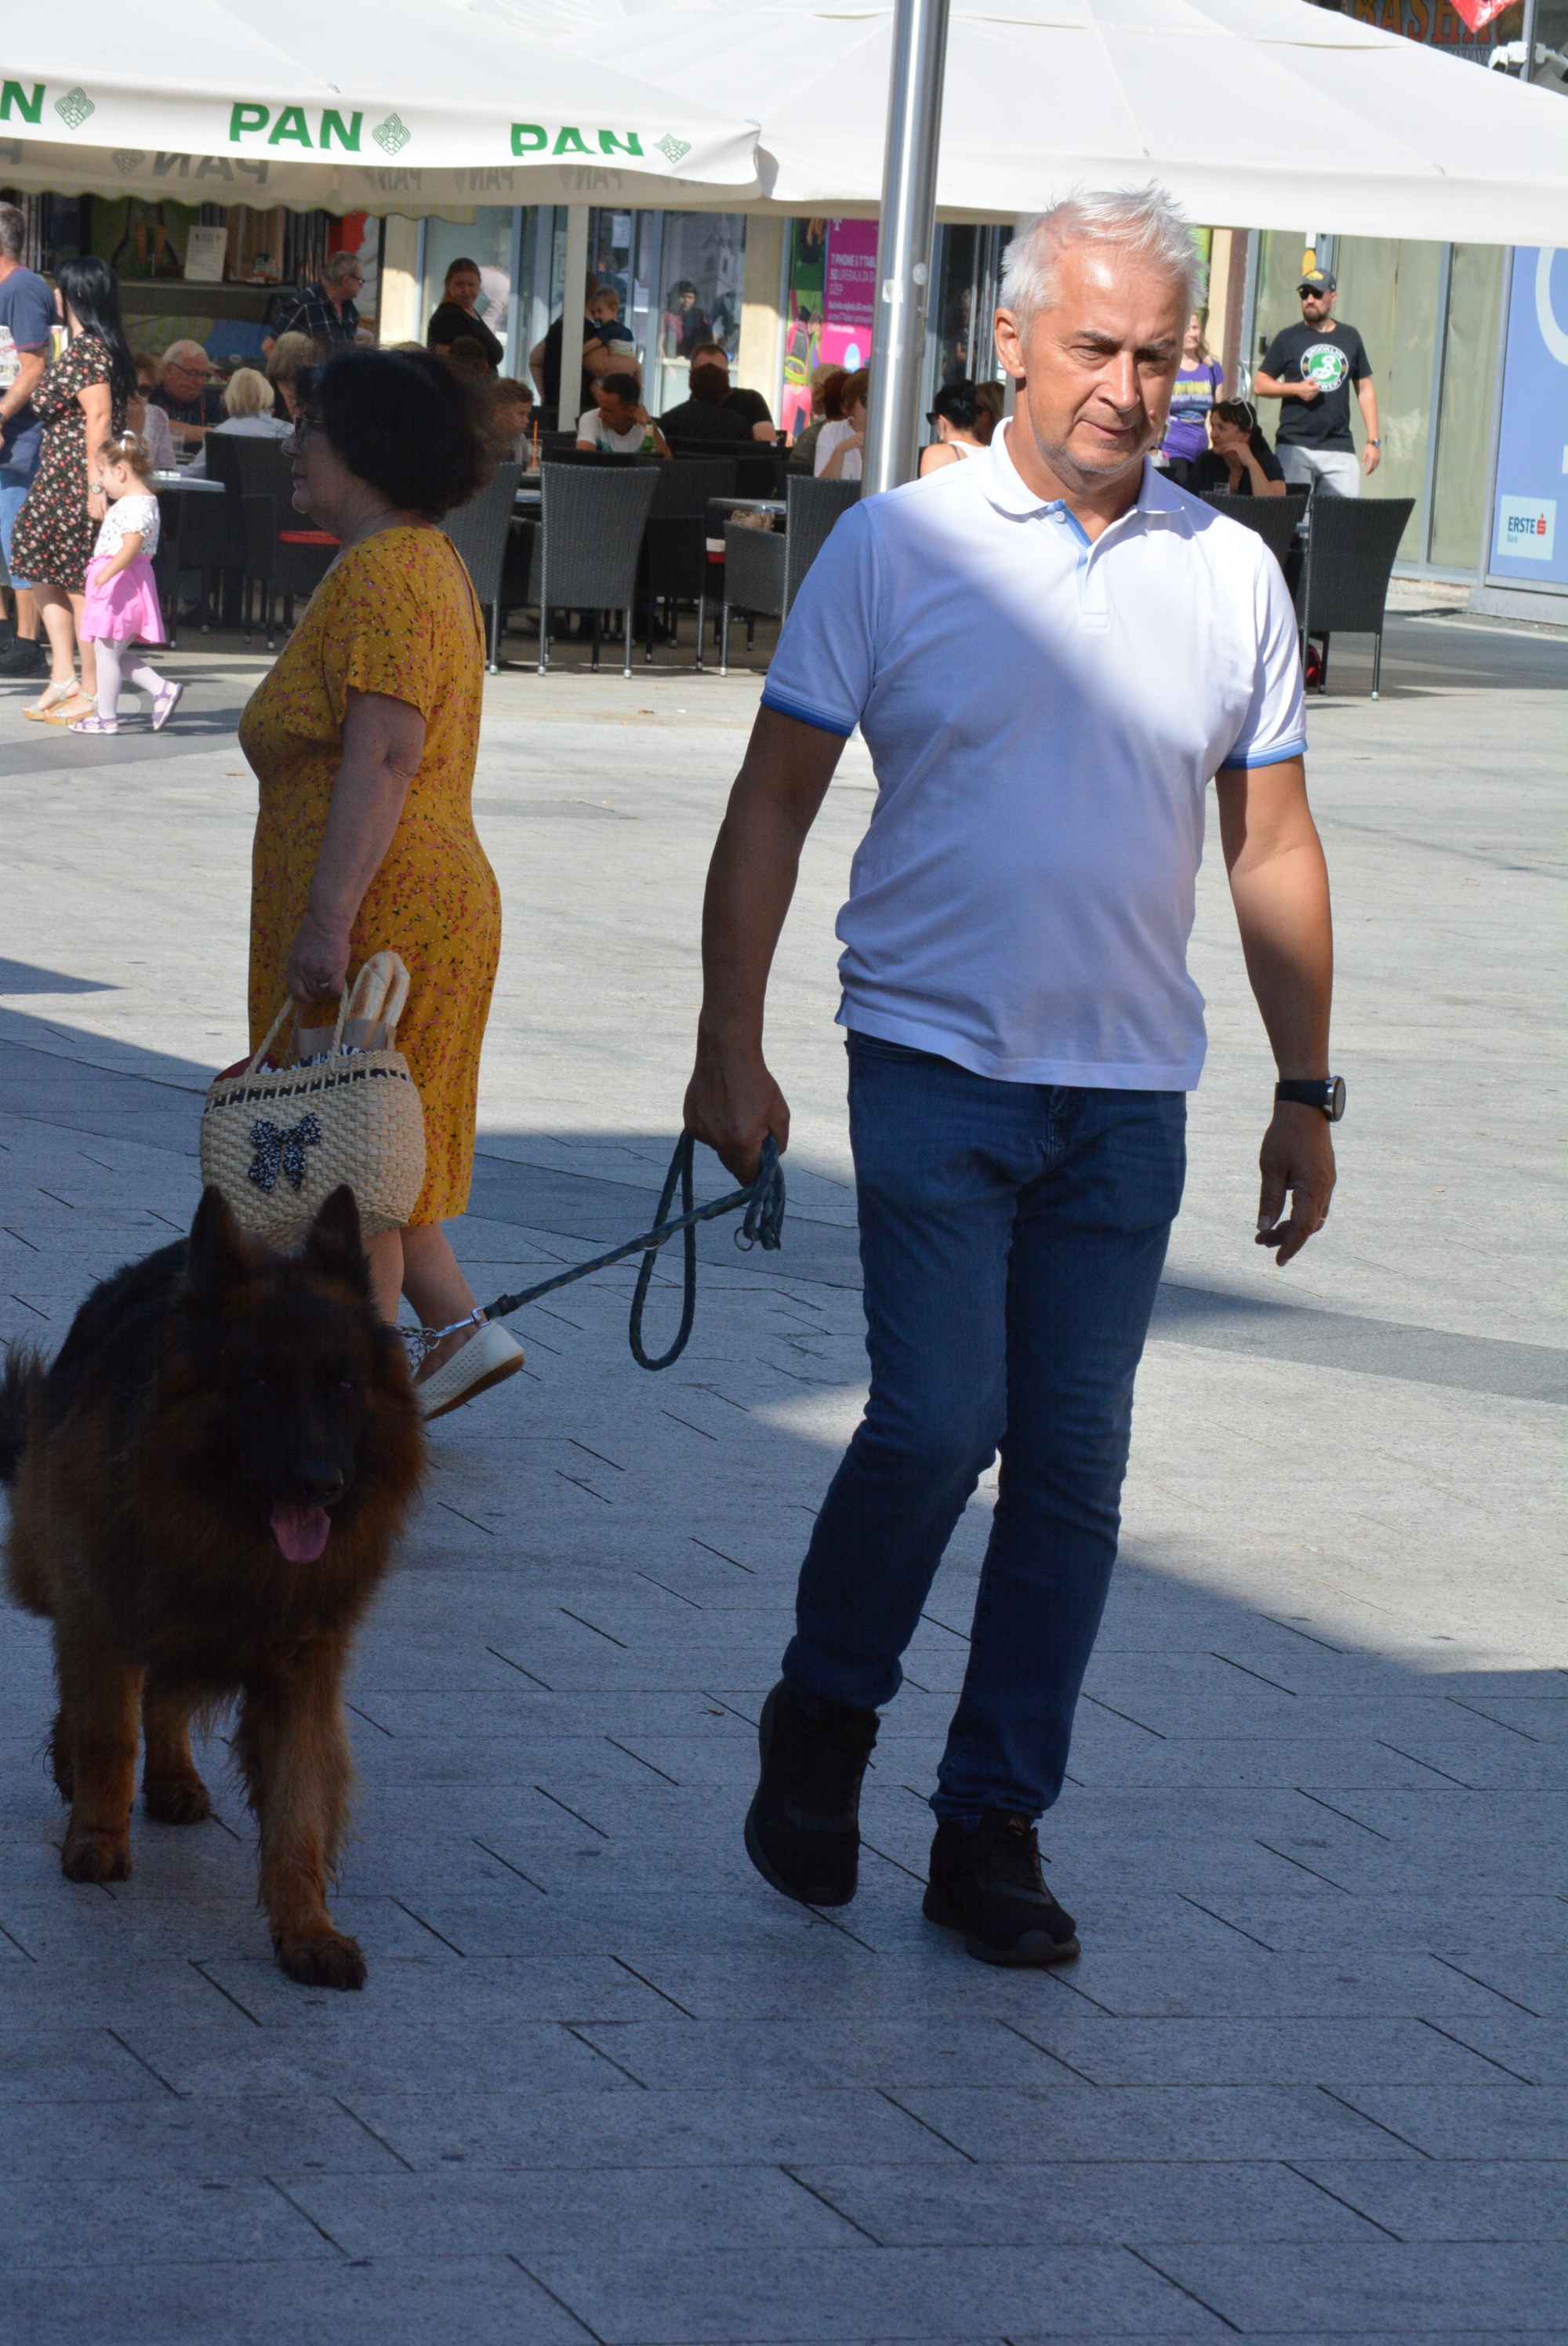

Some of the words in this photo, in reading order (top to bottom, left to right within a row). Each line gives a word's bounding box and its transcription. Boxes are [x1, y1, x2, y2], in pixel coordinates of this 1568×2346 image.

[229, 102, 363, 152] PAN
[510, 122, 644, 157] PAN
[1508, 516, 1536, 534] ERSTE
